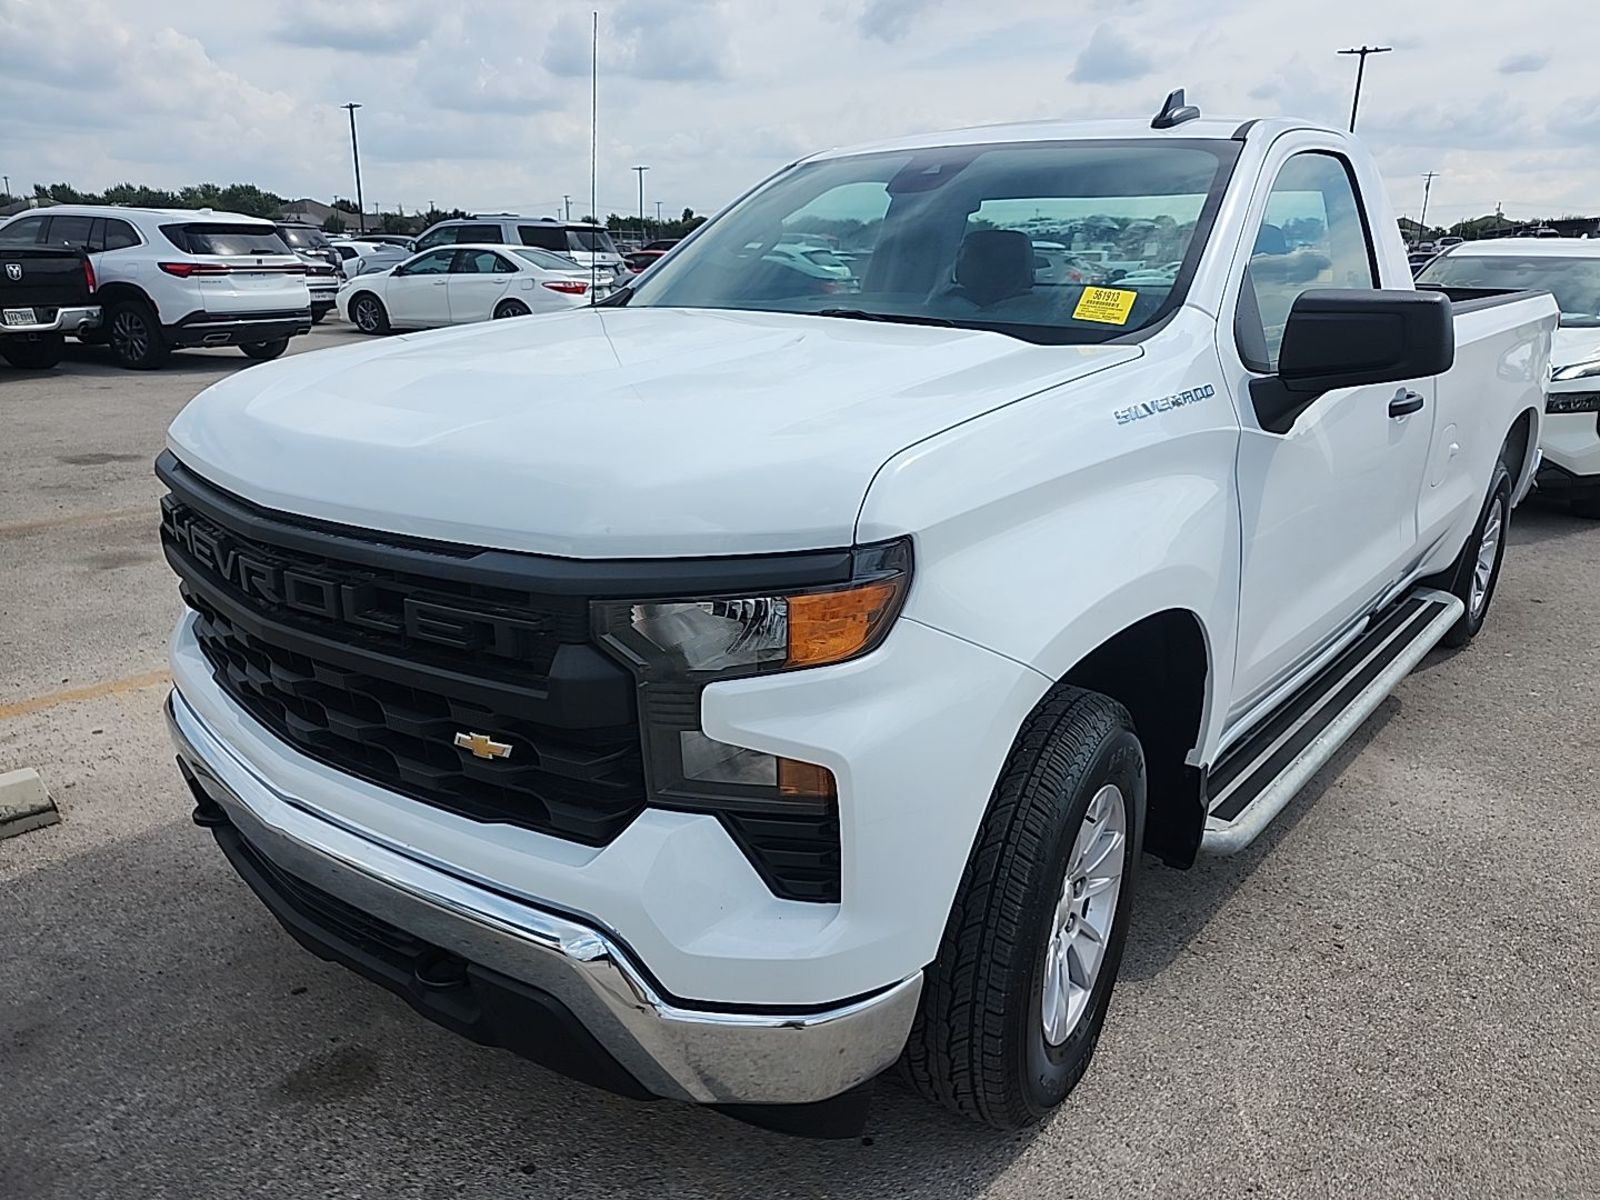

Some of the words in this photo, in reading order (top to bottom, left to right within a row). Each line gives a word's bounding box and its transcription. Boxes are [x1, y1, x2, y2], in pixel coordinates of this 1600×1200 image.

[1093, 290, 1120, 302] 561913
[1114, 384, 1215, 425] SILVERADO
[161, 497, 544, 659] CHEVROLET
